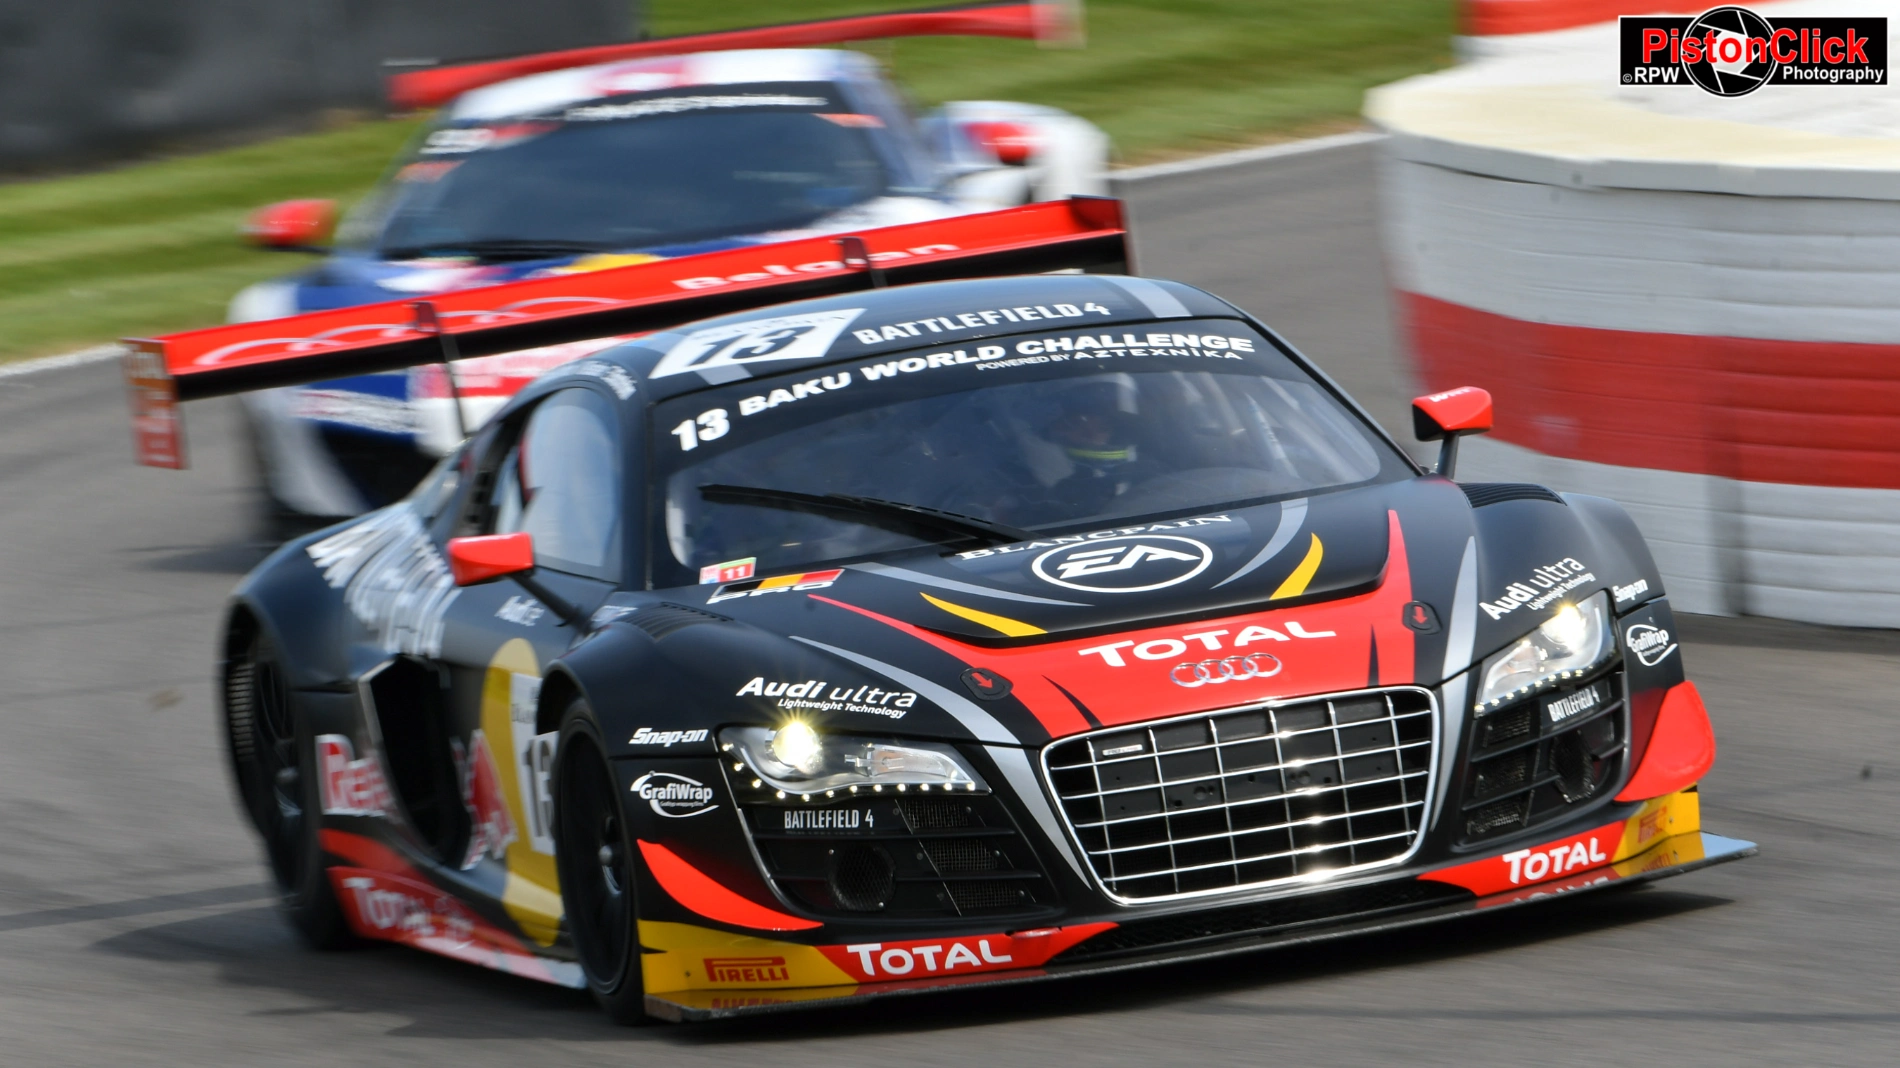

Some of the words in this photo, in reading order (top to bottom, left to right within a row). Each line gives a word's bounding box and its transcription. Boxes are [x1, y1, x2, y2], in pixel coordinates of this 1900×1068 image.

[852, 303, 1085, 345] BATTLEFIELD
[1084, 302, 1112, 316] 4
[684, 325, 816, 367] 13
[975, 355, 1050, 371] POWERED
[1049, 353, 1071, 362] BY
[671, 408, 731, 452] 13
[738, 371, 852, 416] BAKU
[860, 345, 1006, 381] WORLD
[1016, 333, 1256, 355] CHALLENGE
[955, 514, 1233, 561] BLANCPAIN
[724, 566, 746, 579] 11
[1056, 544, 1202, 579] EA
[1479, 582, 1540, 621] Audi
[1530, 557, 1586, 589] ultra
[1077, 621, 1338, 667] TOTAL
[736, 676, 828, 699] Audi
[829, 685, 918, 708] ultra
[777, 698, 844, 711] Lightweight
[845, 702, 907, 719] Technology
[1547, 688, 1595, 722] BATTLEFIELD
[628, 727, 709, 748] Snap-on
[639, 782, 713, 804] GrafiWrap
[784, 809, 860, 829] BATTLEFIELD
[864, 808, 874, 828] 4
[1502, 836, 1606, 885] TOTAL
[703, 955, 790, 983] PIRELLI
[846, 939, 1013, 976] TOTAL
